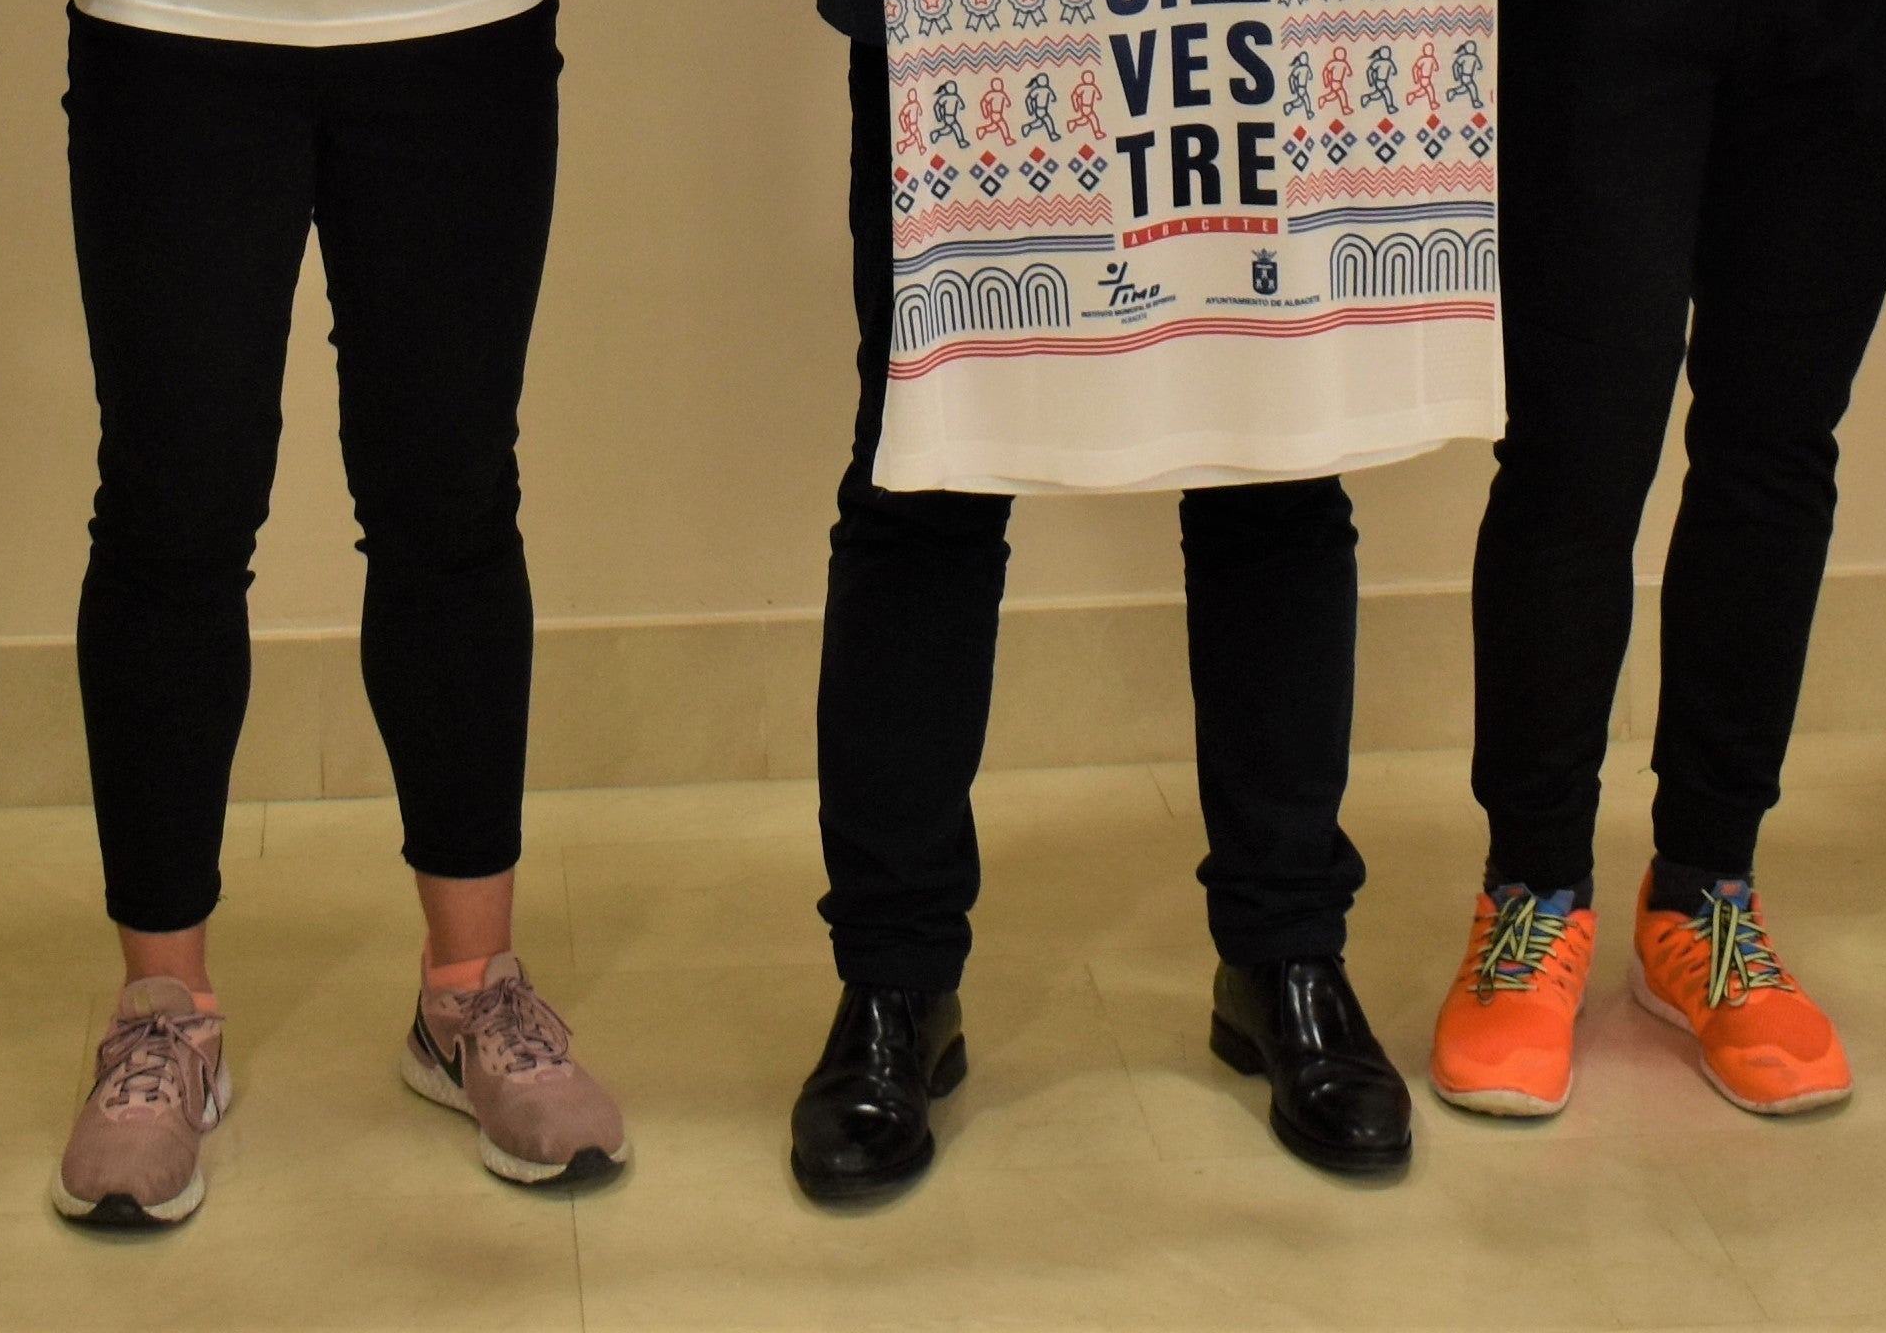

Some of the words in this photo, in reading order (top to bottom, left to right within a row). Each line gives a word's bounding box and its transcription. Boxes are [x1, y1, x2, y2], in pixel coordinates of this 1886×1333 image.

[1109, 20, 1275, 118] VES
[1116, 122, 1278, 218] TRE
[1130, 219, 1269, 245] ALBACETE
[1205, 297, 1269, 307] AYUNTAMIENTO
[1271, 299, 1282, 307] DE
